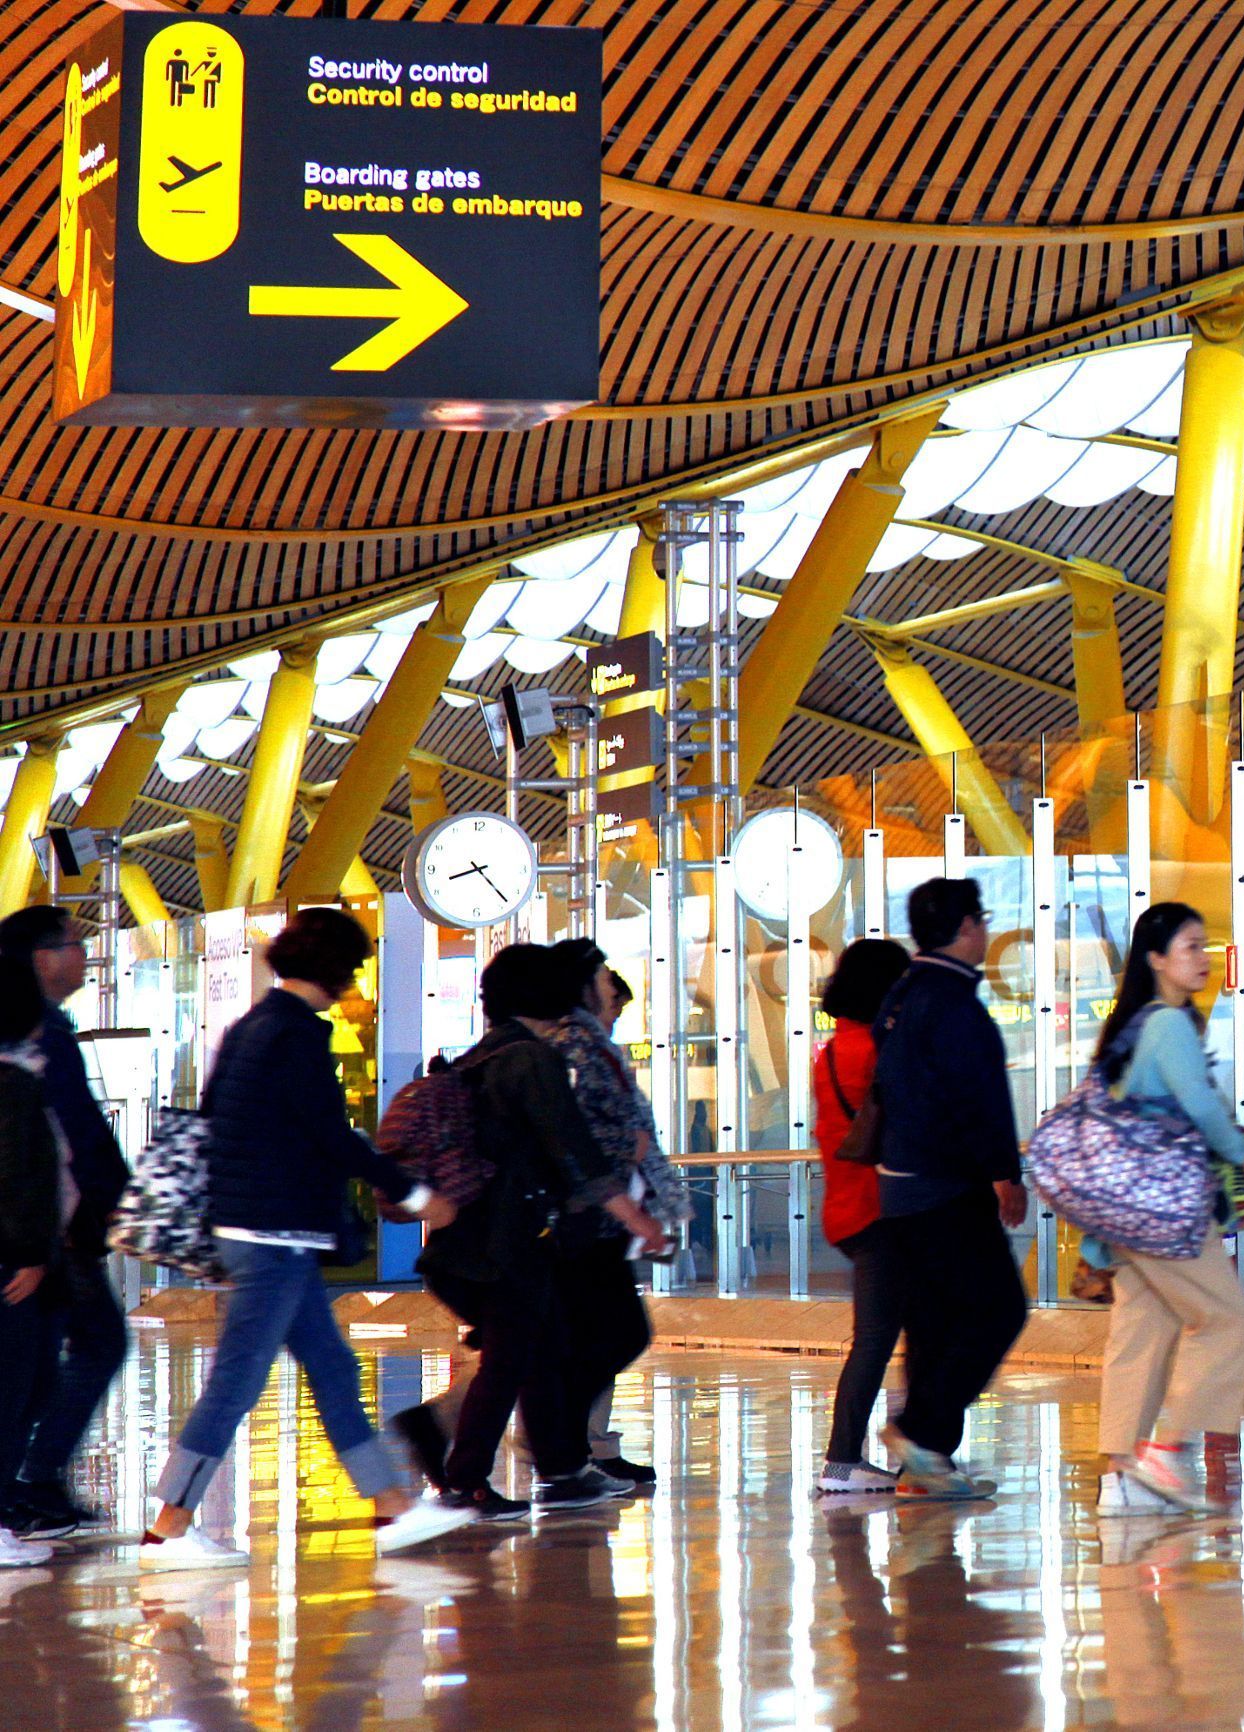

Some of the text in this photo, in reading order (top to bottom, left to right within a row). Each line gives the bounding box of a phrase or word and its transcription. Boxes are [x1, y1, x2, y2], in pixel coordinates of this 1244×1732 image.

[308, 56, 488, 84] Security control
[307, 83, 577, 114] Control de seguridad
[304, 162, 481, 191] Boarding gates
[304, 189, 583, 220] Puertas de embarque
[474, 821, 486, 831] 12
[427, 865, 436, 875] 9
